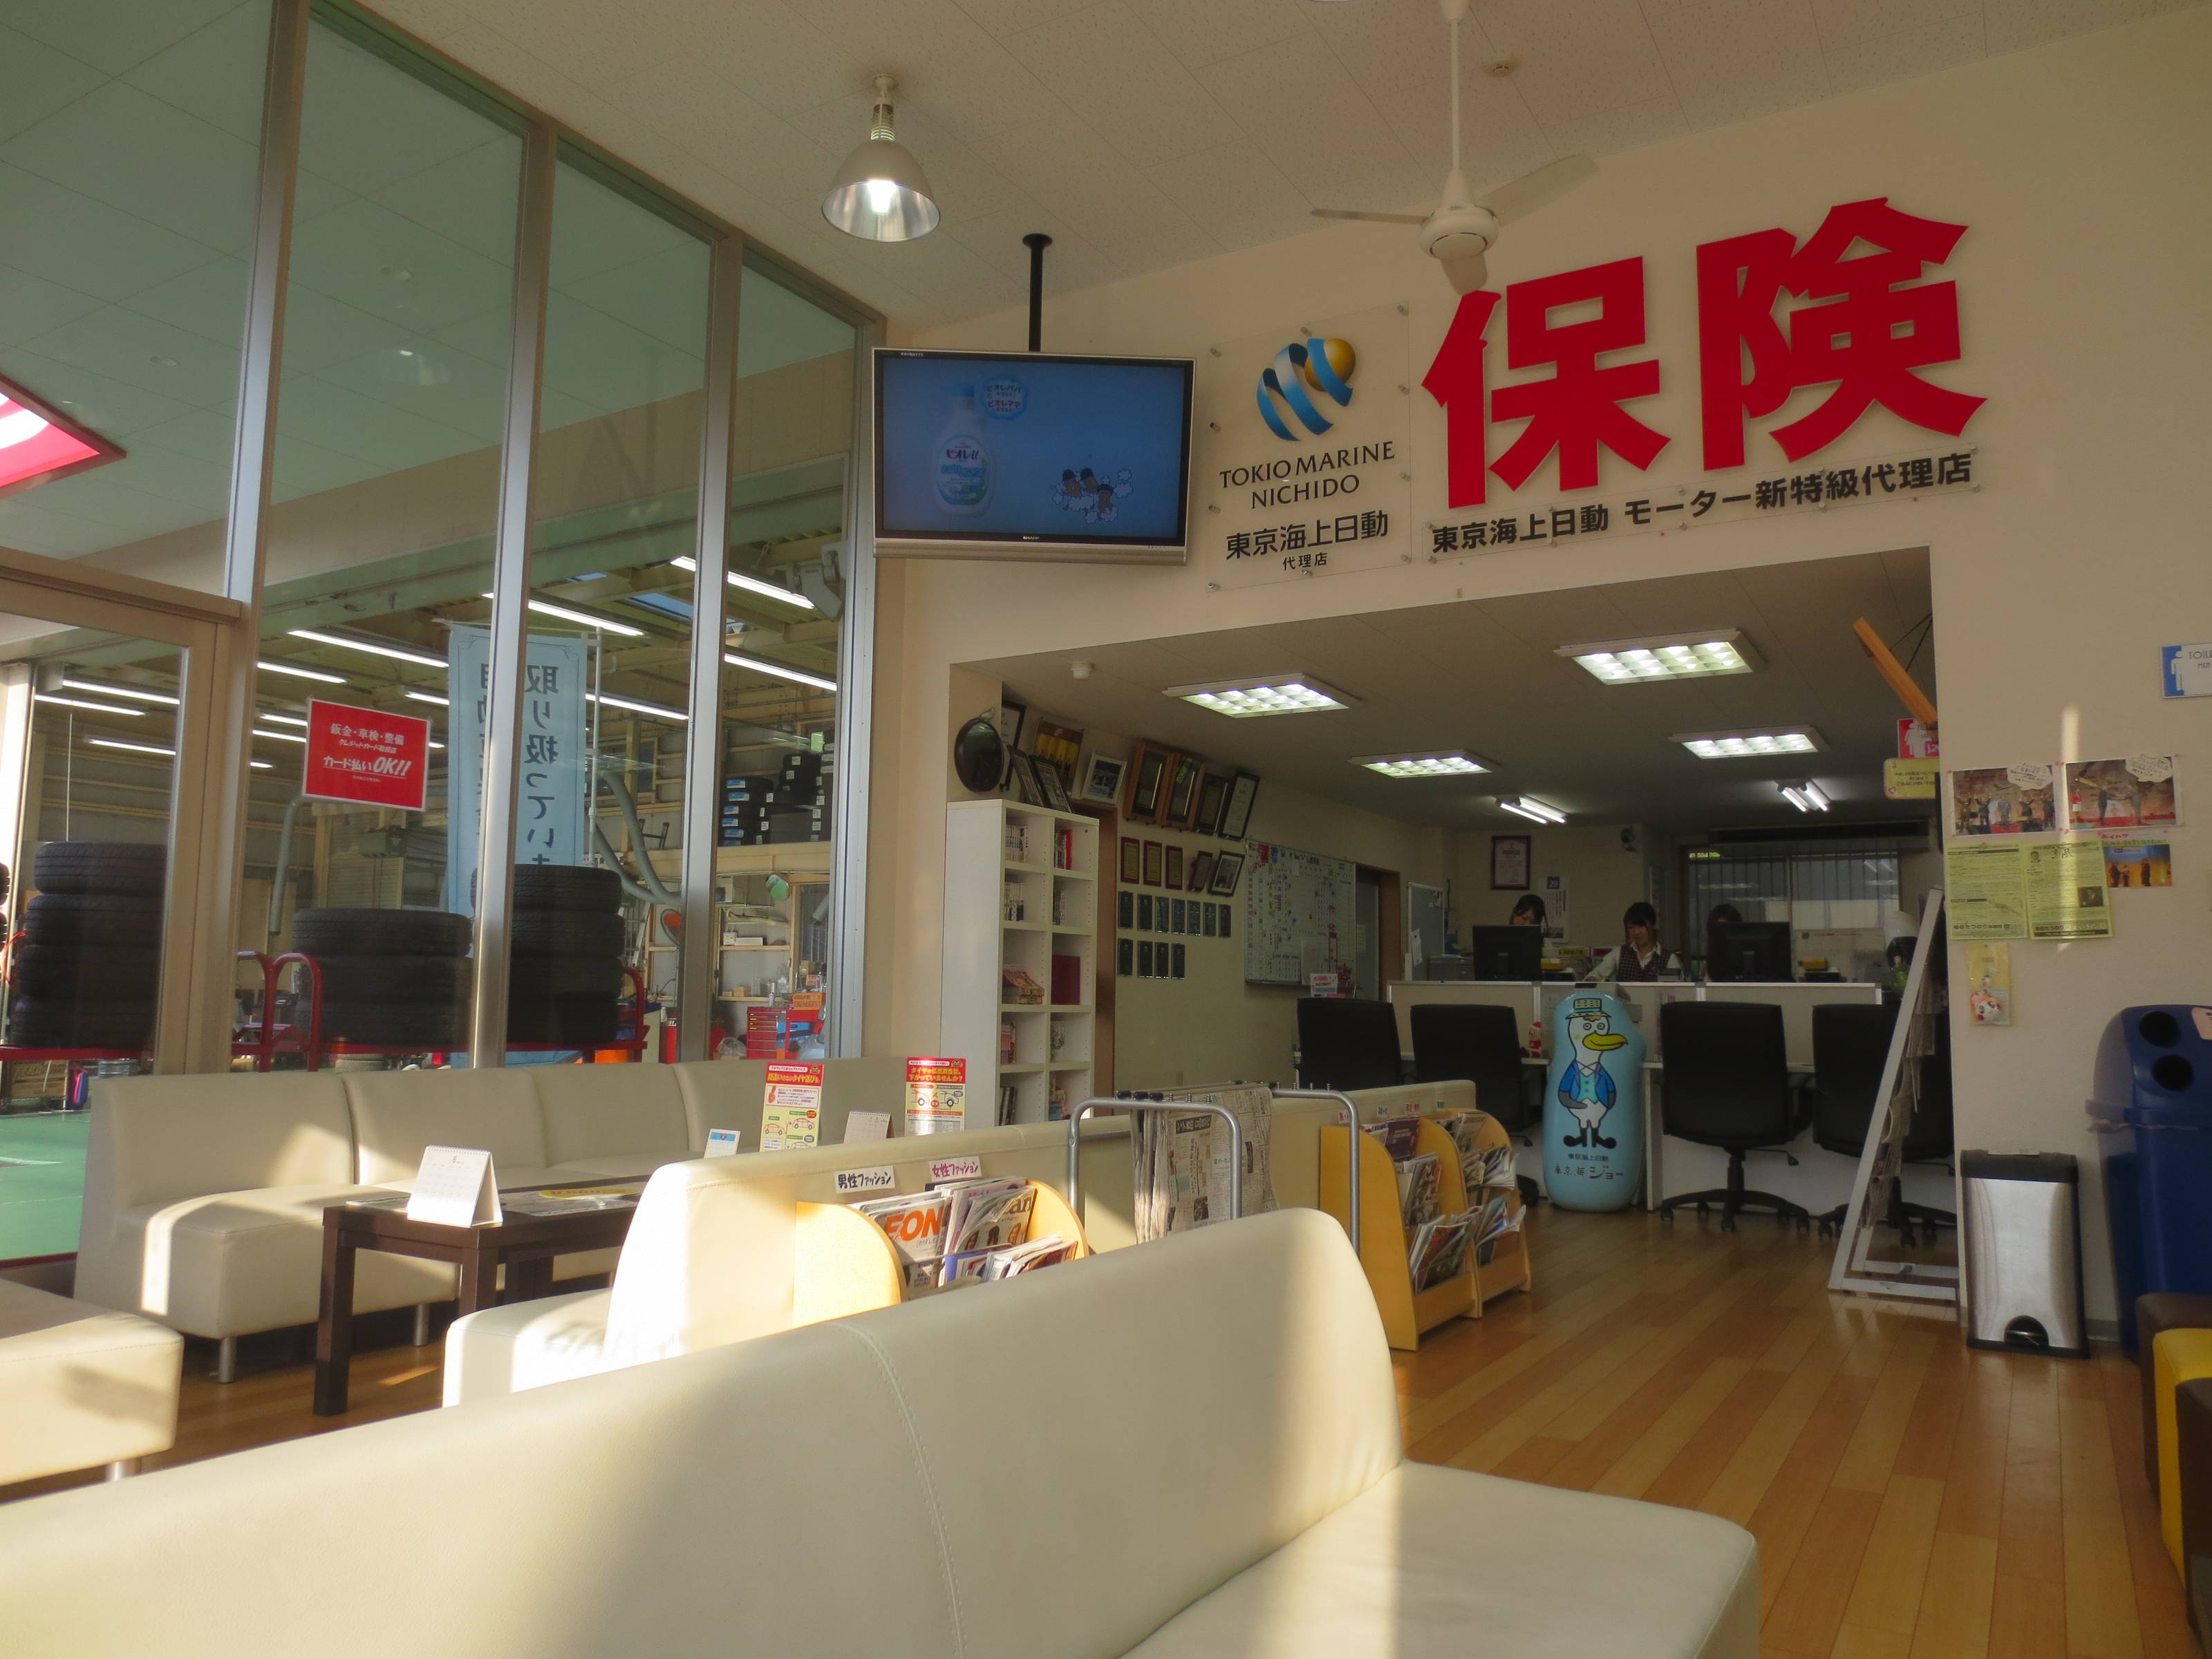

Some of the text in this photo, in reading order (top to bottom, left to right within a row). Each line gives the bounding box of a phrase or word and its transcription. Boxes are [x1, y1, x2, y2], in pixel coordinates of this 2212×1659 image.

[1421, 197, 1987, 509] 保険
[1219, 441, 1395, 488] TOKIO MARINE
[1251, 474, 1359, 509] NICHIDO
[1432, 453, 1974, 554] 東京海上日動 モーター新特級代理店
[1226, 509, 1389, 561] 東京海上日動
[1283, 552, 1327, 571] 代理店
[838, 1172, 892, 1189] 男性ファッション
[932, 1161, 979, 1178] 女性ファッション
